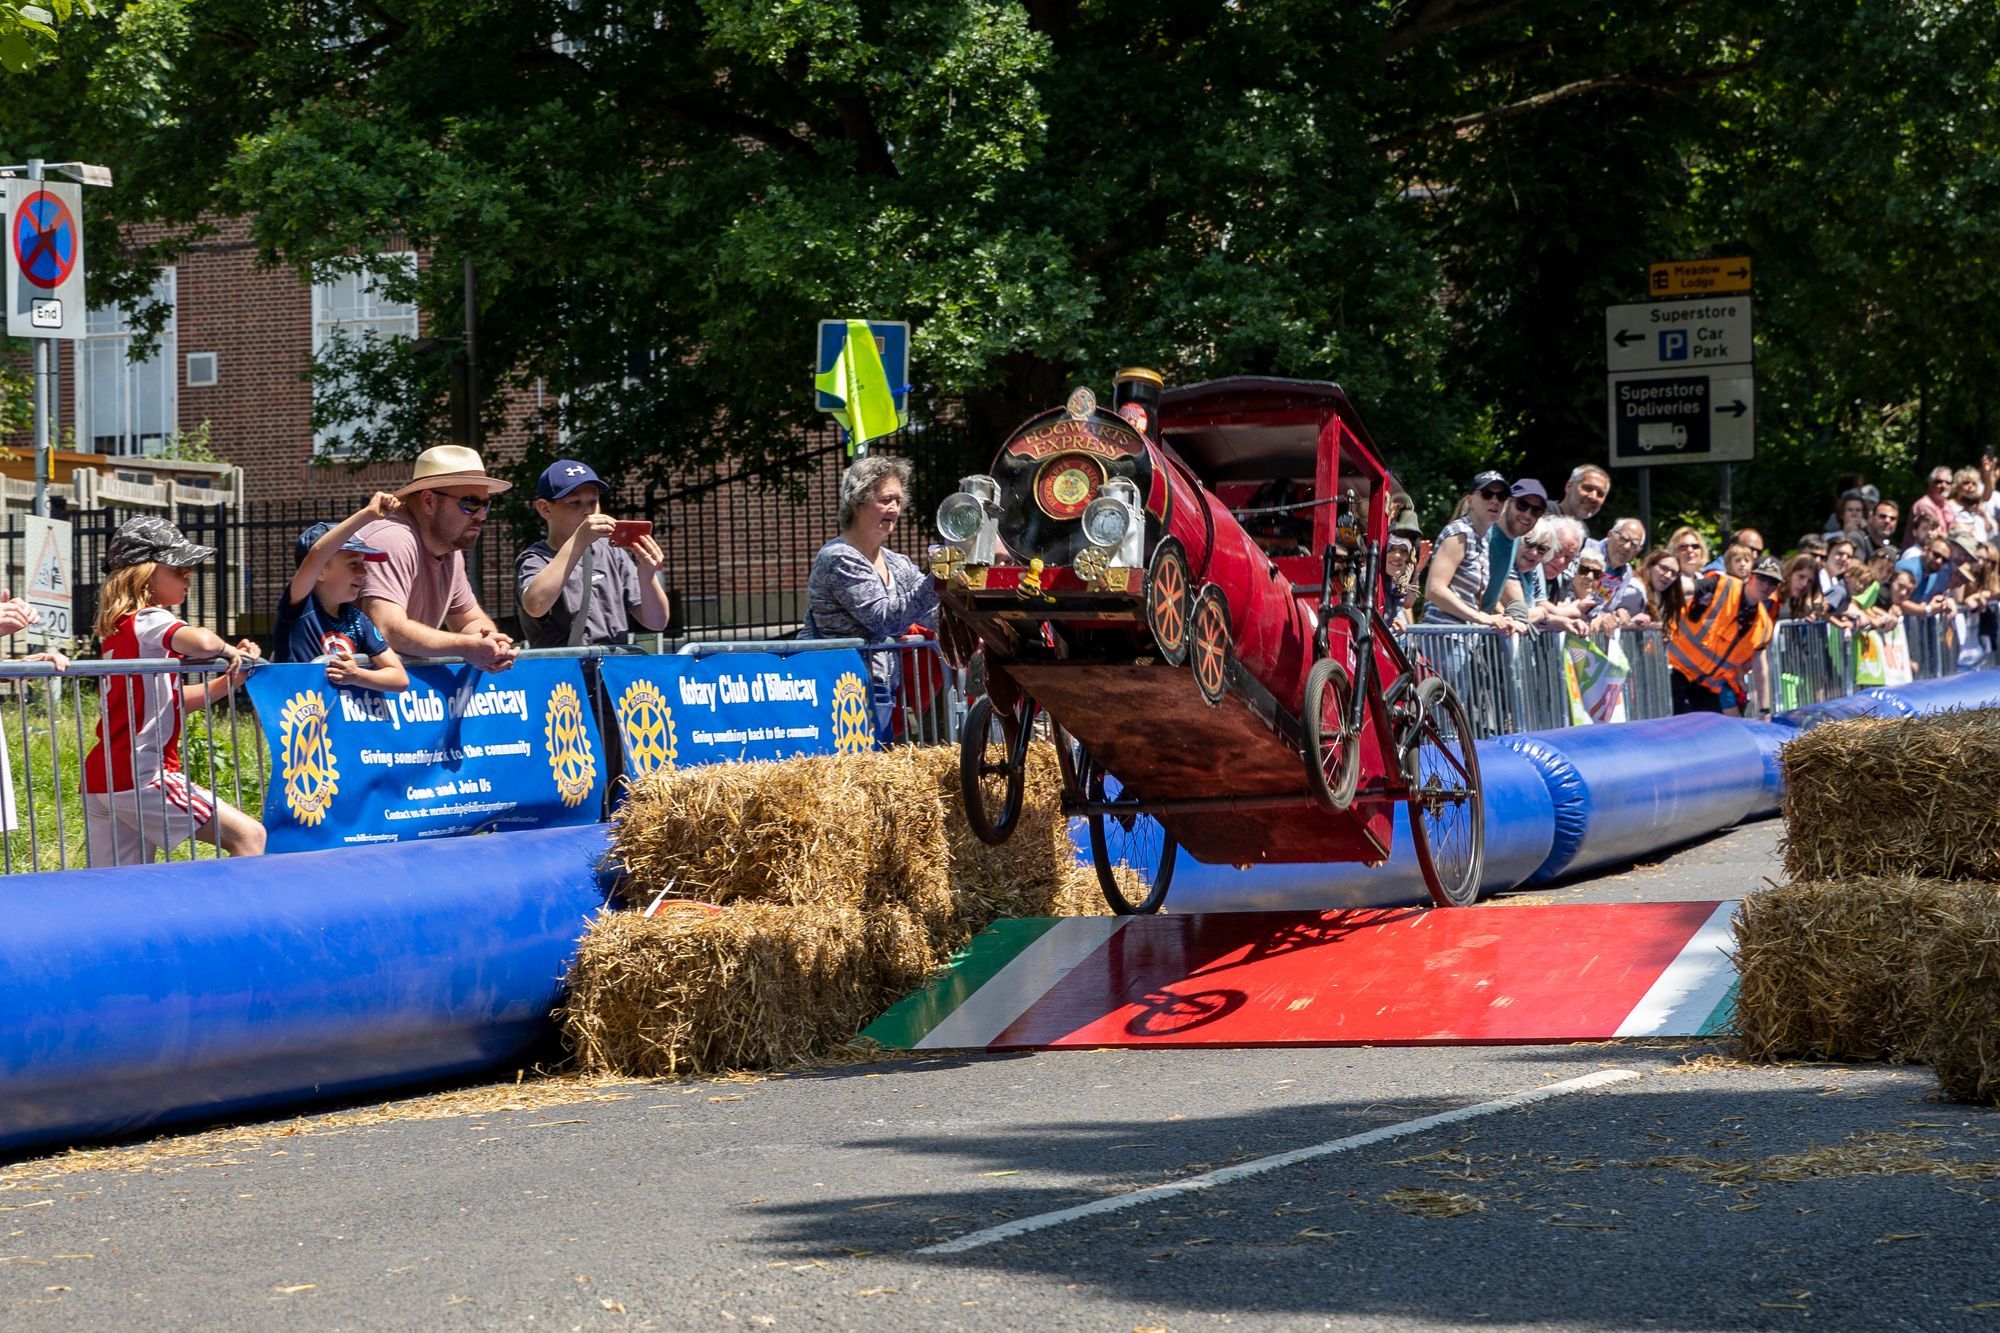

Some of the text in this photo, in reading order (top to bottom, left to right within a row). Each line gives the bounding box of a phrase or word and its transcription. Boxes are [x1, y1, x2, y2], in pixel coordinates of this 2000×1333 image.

[1674, 264, 1721, 276] Meadow
[1681, 277, 1715, 289] Lodge
[37, 305, 57, 319] End
[1650, 305, 1737, 323] Superstore
[1696, 327, 1724, 341] Car
[1665, 333, 1684, 359] P
[1693, 344, 1728, 359] Park
[1620, 383, 1705, 401] Superstore
[1626, 401, 1700, 417] Deliveries
[1024, 421, 1132, 445] HOGWARTS
[1033, 435, 1119, 457] EXPRESS
[48, 610, 67, 634] 20
[679, 673, 818, 713] Rotary Club of Billericay
[400, 689, 444, 723] Club
[692, 724, 819, 746] Giving something back to the community
[360, 749, 393, 767] Giving
[451, 747, 464, 760] to
[463, 744, 484, 758] the
[484, 740, 531, 757] community
[406, 778, 492, 801] Come and Join Us
[384, 808, 411, 820] Contact
